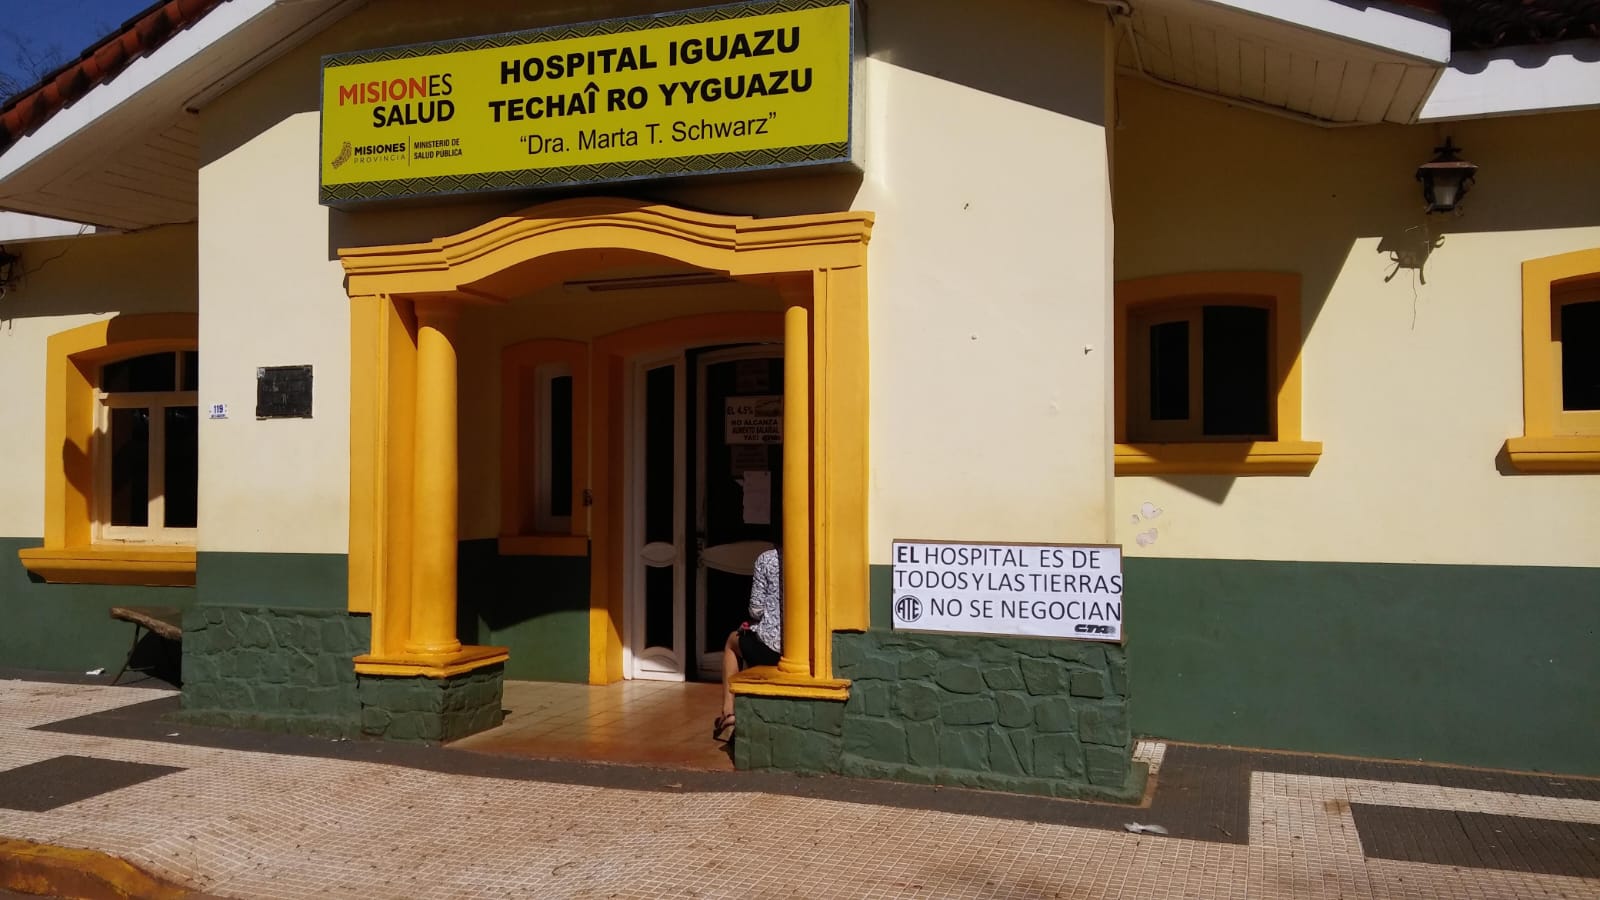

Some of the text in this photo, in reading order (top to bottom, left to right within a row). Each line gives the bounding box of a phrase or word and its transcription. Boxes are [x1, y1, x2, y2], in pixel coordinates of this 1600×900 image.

[501, 26, 800, 84] HOSPITAL IGUAZU
[339, 73, 452, 106] MISIONES
[488, 67, 813, 122] TECHAÎ RO YYGUAZU
[373, 99, 455, 128] SALUD
[414, 138, 460, 149] MINISTERIO DE
[578, 128, 638, 150] Marta
[645, 123, 663, 144] T.
[354, 142, 406, 156] MISIONES
[354, 154, 406, 164] PROVINCIA
[414, 151, 434, 160] SALUD
[897, 546, 1100, 569] EL HOSPITAL ES DE
[895, 570, 1122, 594] TODOS Y LAS TIERRAS
[897, 597, 920, 620] ATE
[931, 598, 1121, 621] NO SE NEGOCIAN
